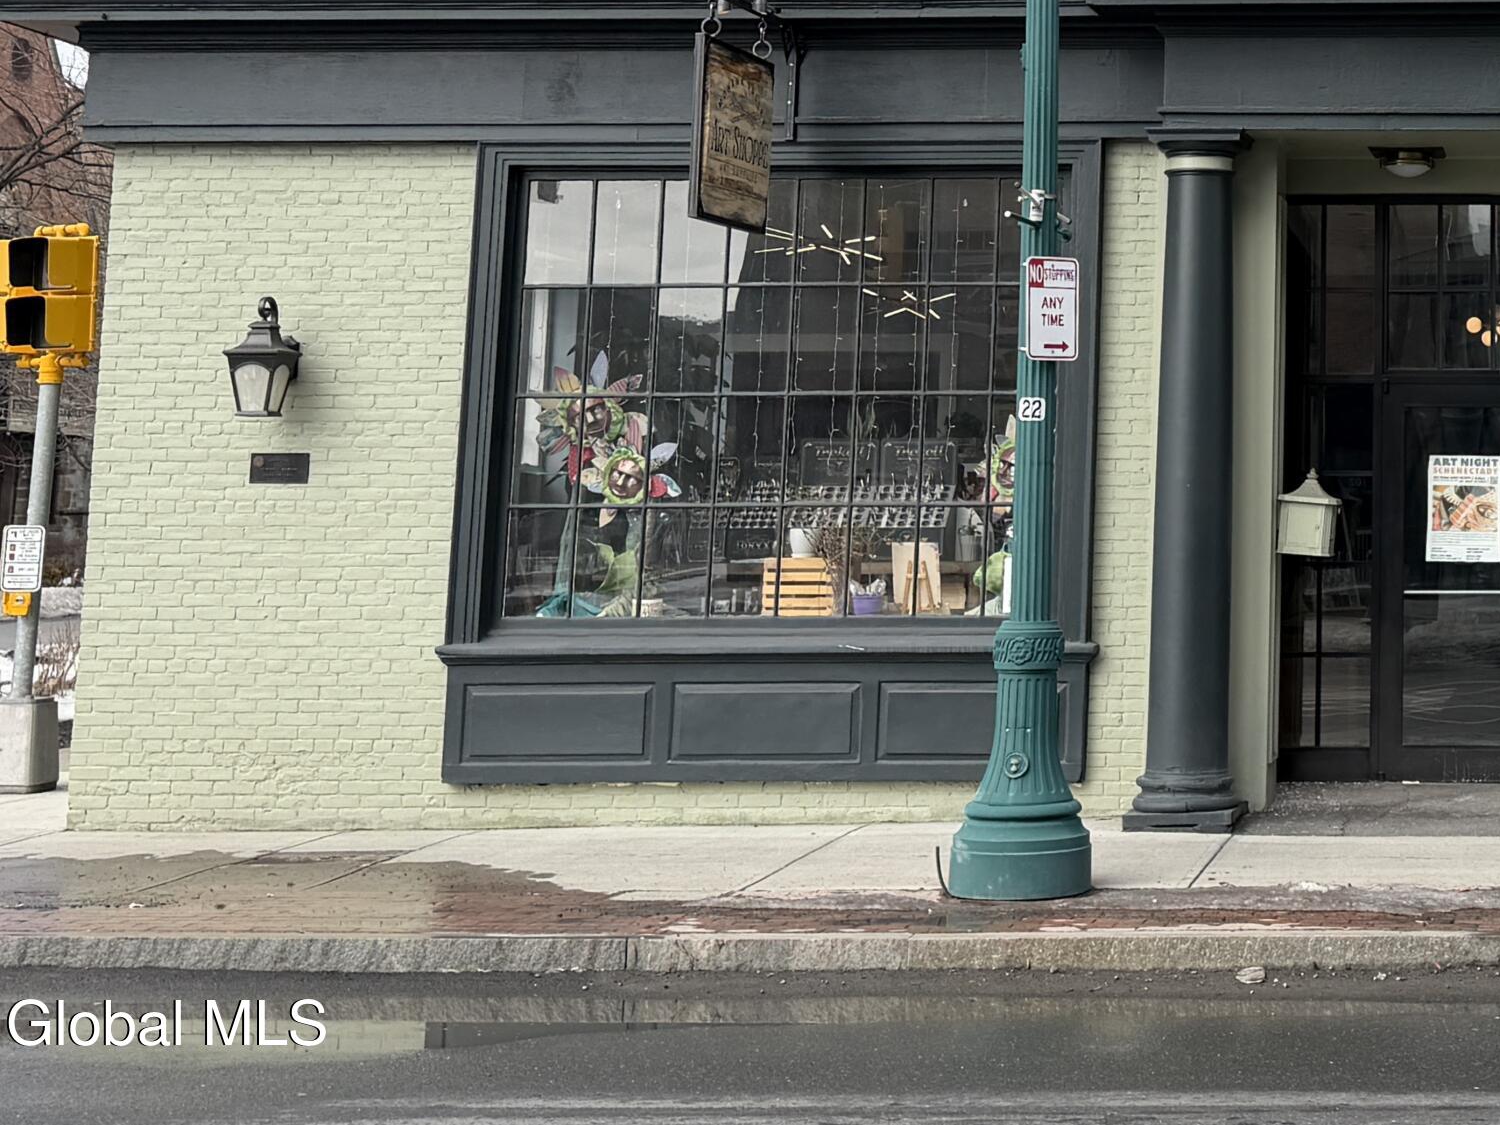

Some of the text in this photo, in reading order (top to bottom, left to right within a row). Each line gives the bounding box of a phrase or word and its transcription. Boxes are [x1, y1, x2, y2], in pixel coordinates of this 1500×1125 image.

[711, 119, 769, 169] ART SHOPPE
[1029, 264, 1075, 283] NO STOPPING
[1041, 296, 1064, 309] ANY
[1041, 314, 1065, 327] TIME
[1021, 399, 1042, 418] 22
[1433, 458, 1499, 467] ART NIGHT
[1433, 467, 1498, 475] SCHENECTADY
